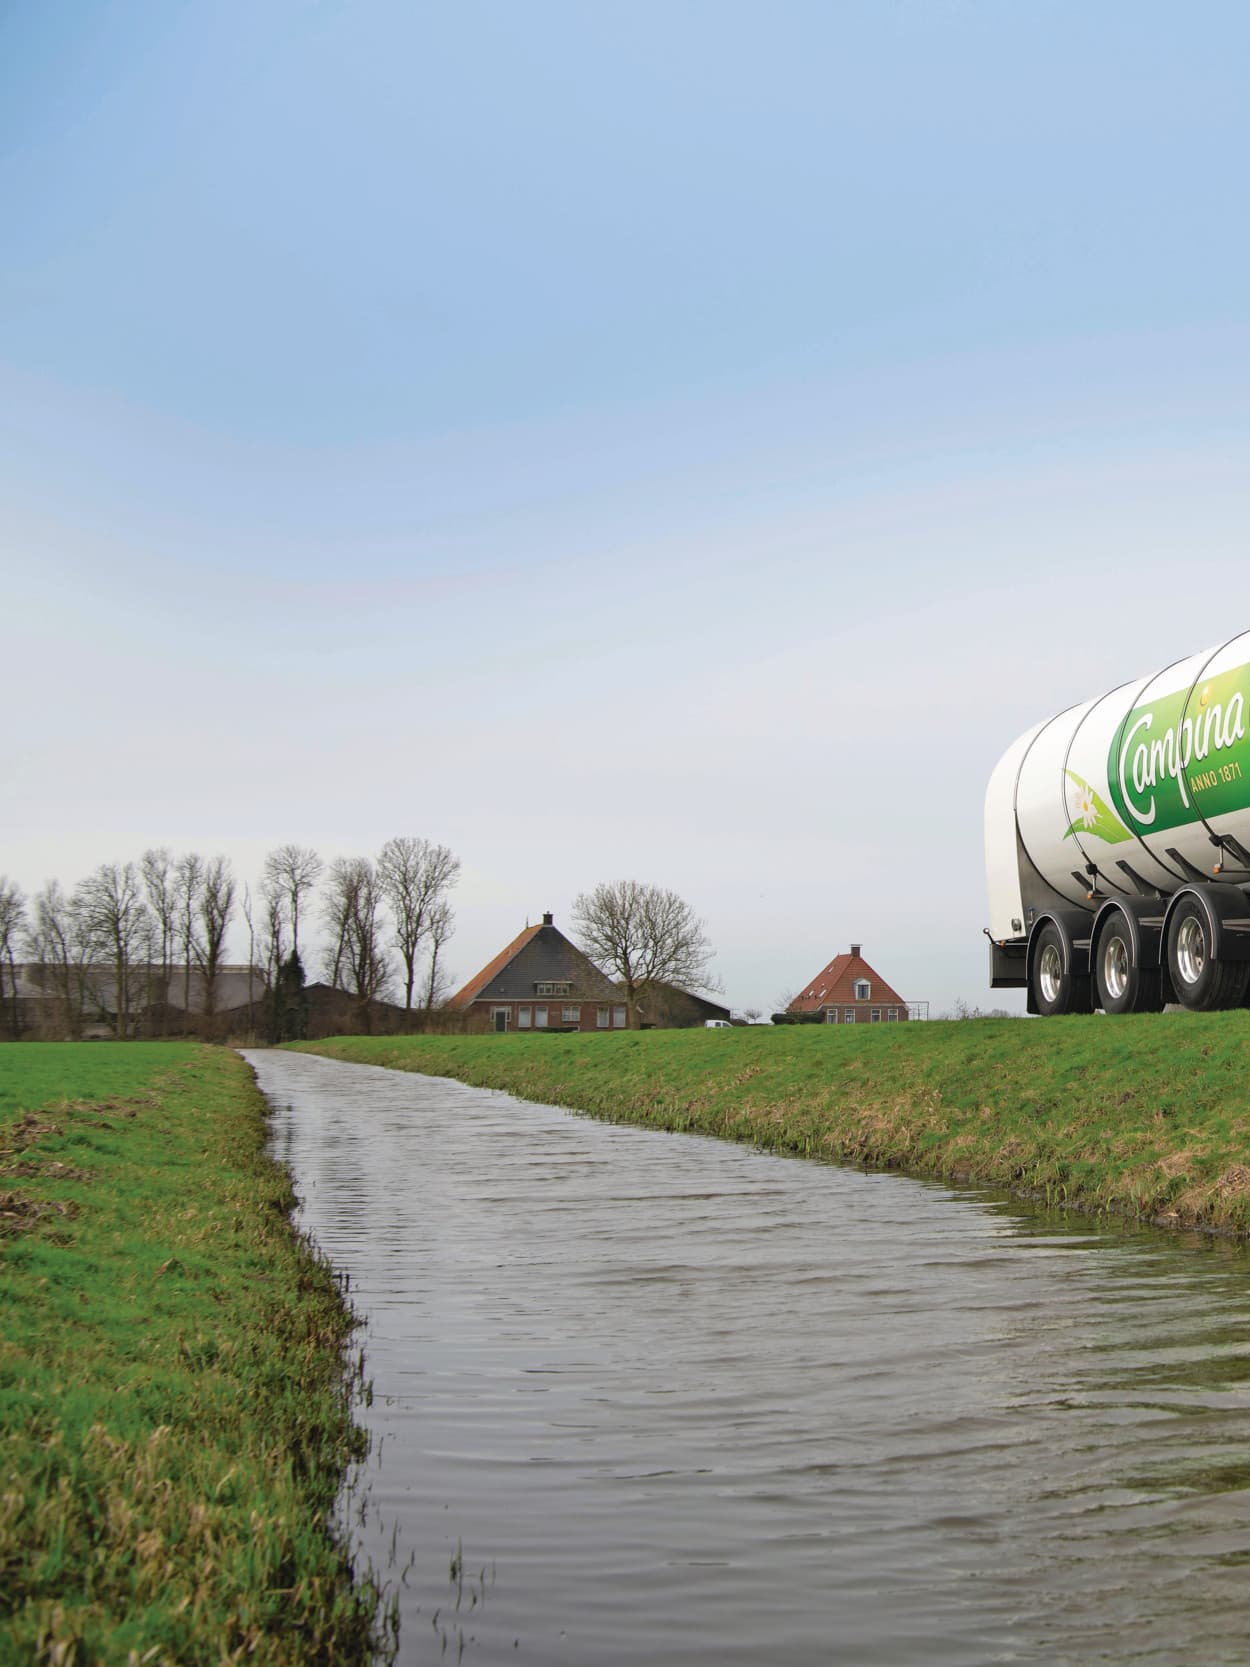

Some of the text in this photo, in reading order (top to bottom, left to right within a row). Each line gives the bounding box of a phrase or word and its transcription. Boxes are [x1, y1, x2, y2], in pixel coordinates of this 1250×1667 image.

[1119, 687, 1245, 825] Campina
[1189, 762, 1243, 793] ANNO 1871
